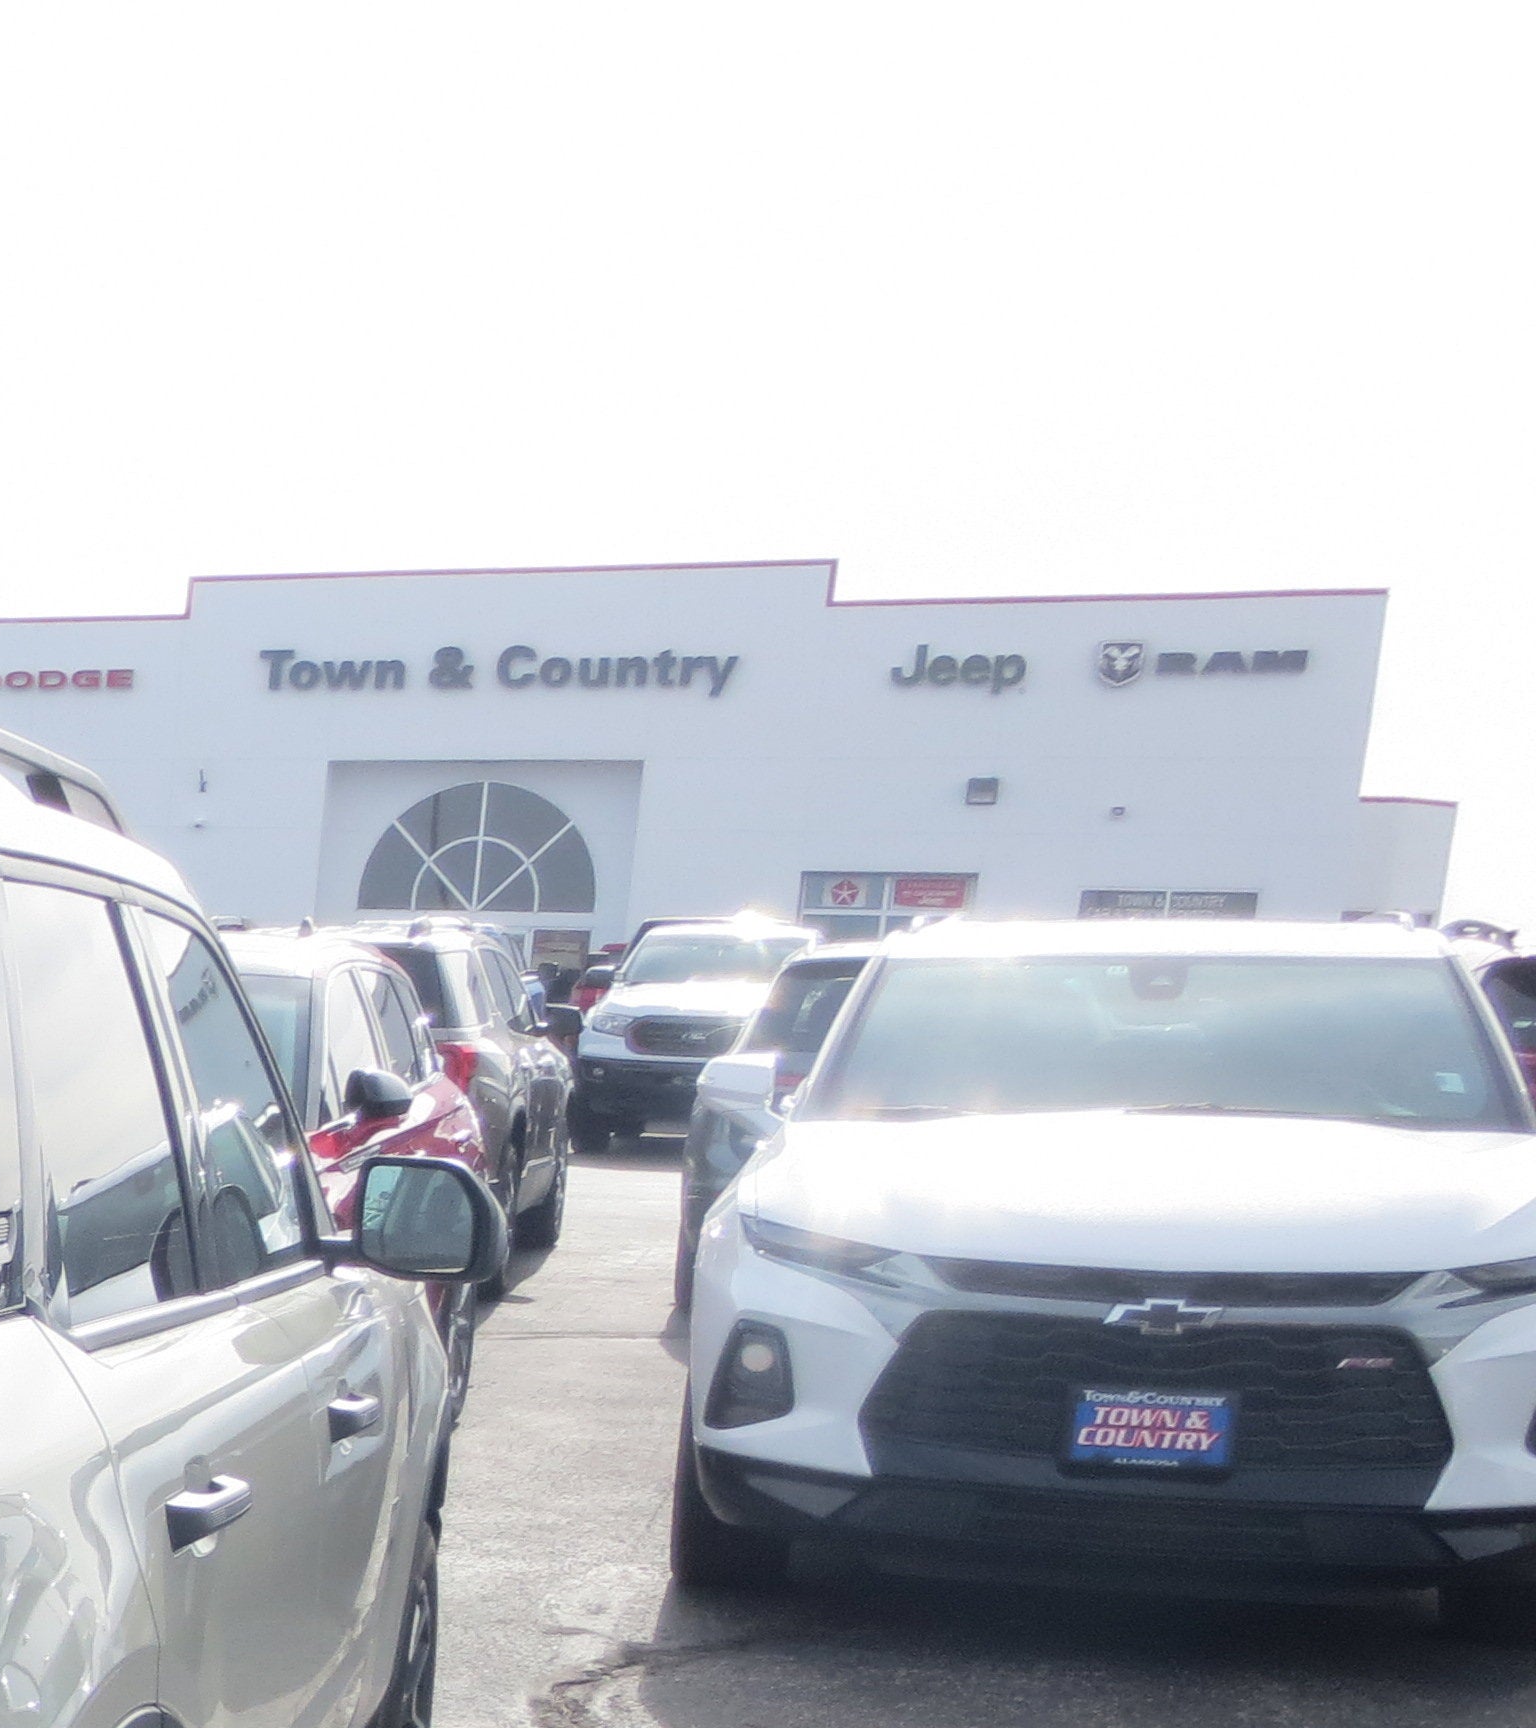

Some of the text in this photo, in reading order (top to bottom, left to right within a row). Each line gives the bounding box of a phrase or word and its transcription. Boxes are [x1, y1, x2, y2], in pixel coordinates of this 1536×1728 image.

[259, 645, 739, 698] Town & Country
[890, 643, 1028, 695] Jeep
[1154, 650, 1309, 675] RAM
[1093, 1406, 1211, 1430] TOWN &
[1077, 1426, 1222, 1452] COUNTRY
